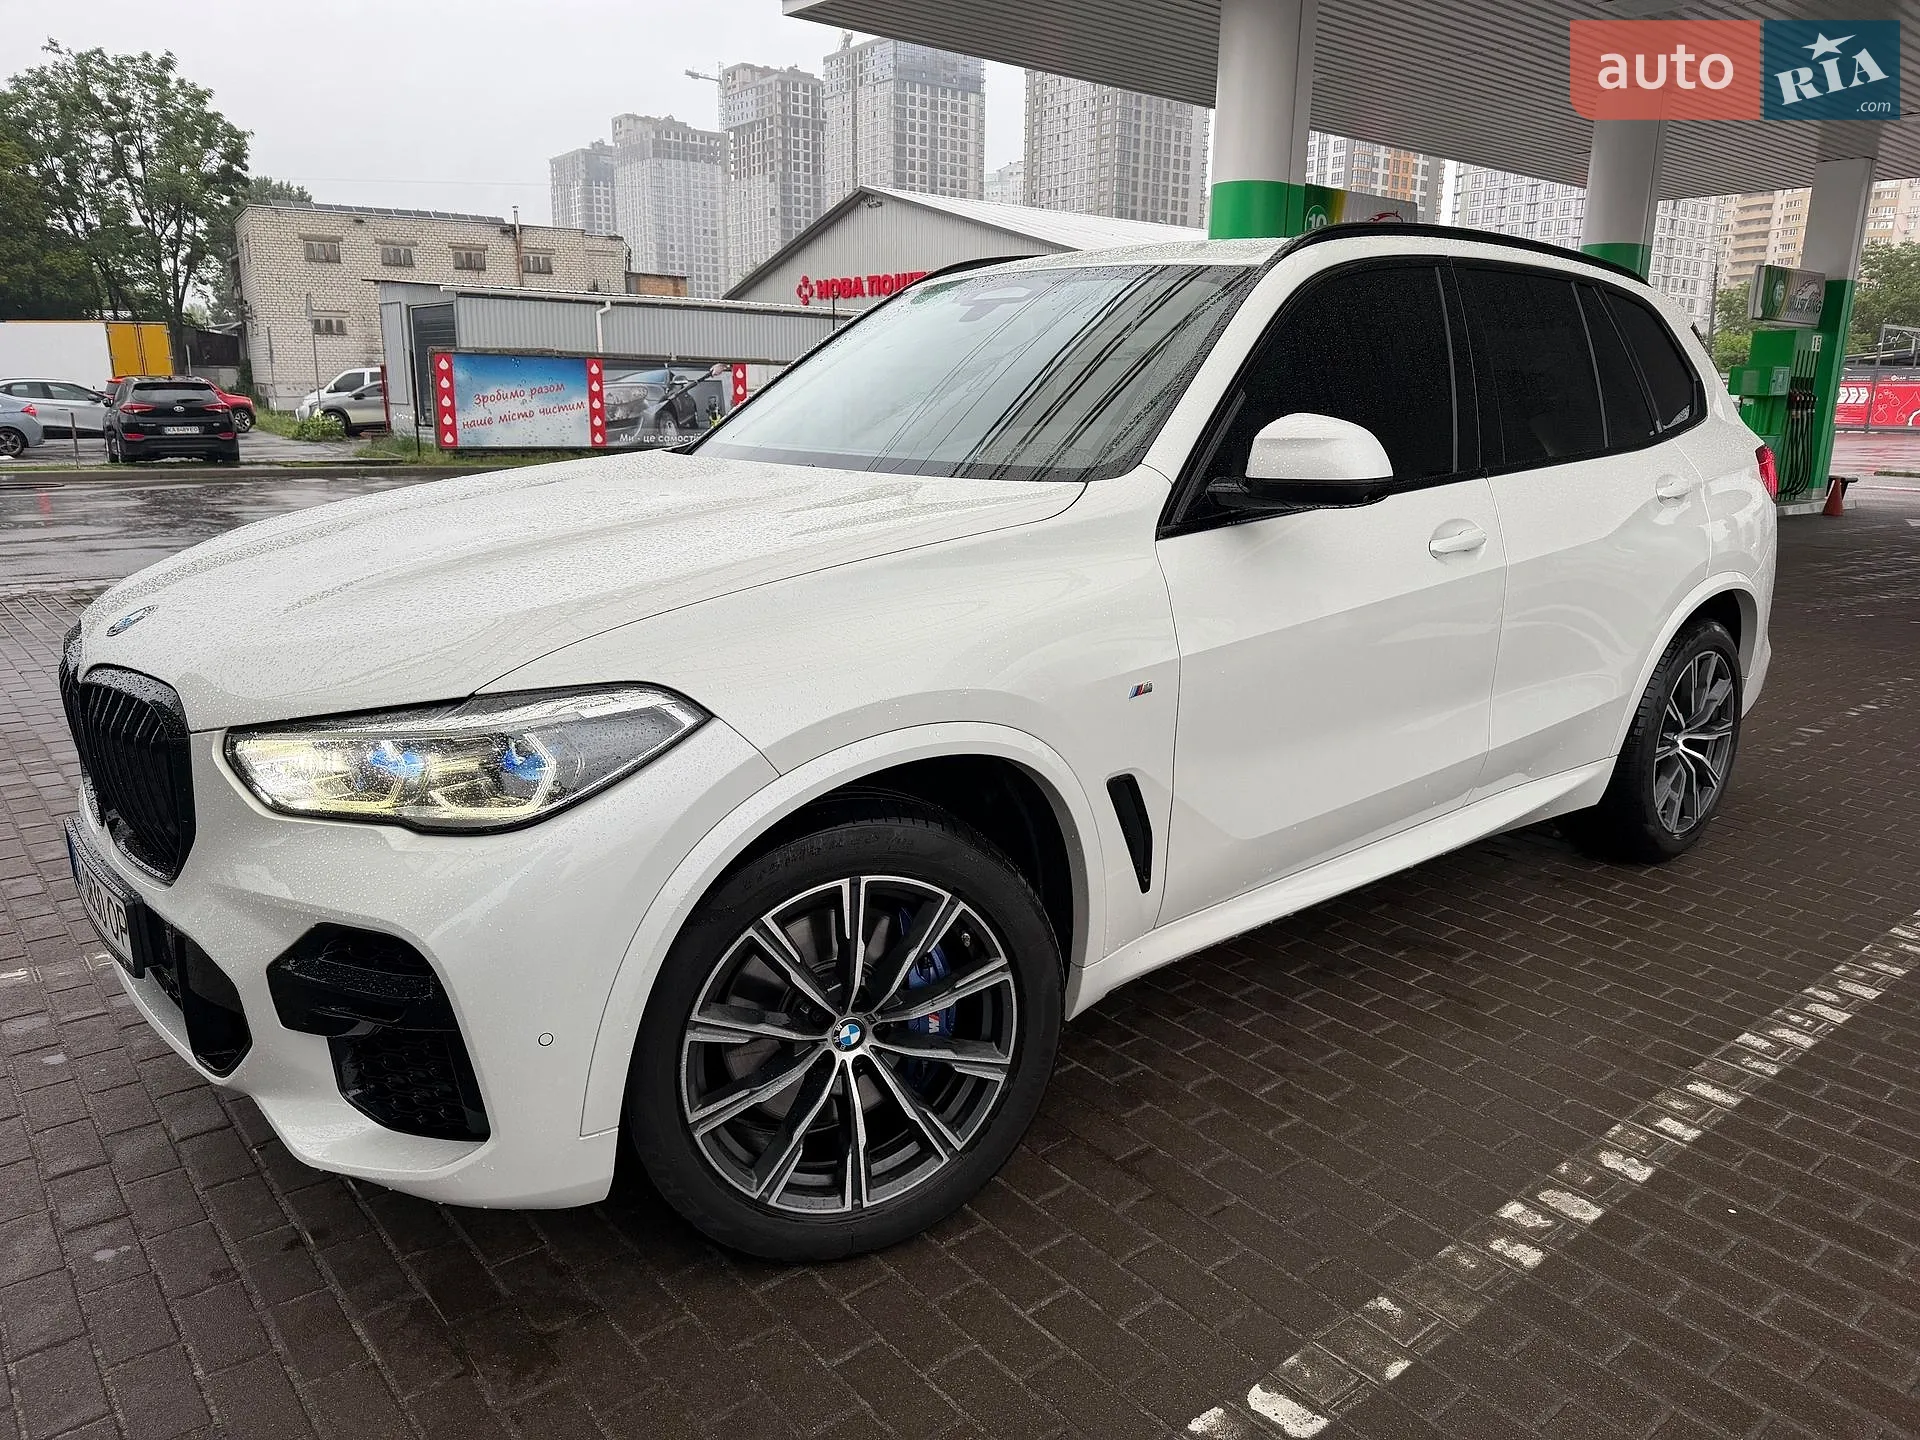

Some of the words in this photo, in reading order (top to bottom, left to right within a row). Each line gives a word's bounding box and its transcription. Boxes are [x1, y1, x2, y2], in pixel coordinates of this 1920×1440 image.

[1309, 213, 1327, 229] 10
[816, 276, 866, 300] НОВА
[473, 388, 526, 409] Зробимо
[530, 382, 566, 399] разом
[462, 415, 495, 430] наше
[498, 410, 535, 424] місто
[539, 401, 586, 416] чистим
[619, 433, 634, 443] Ми
